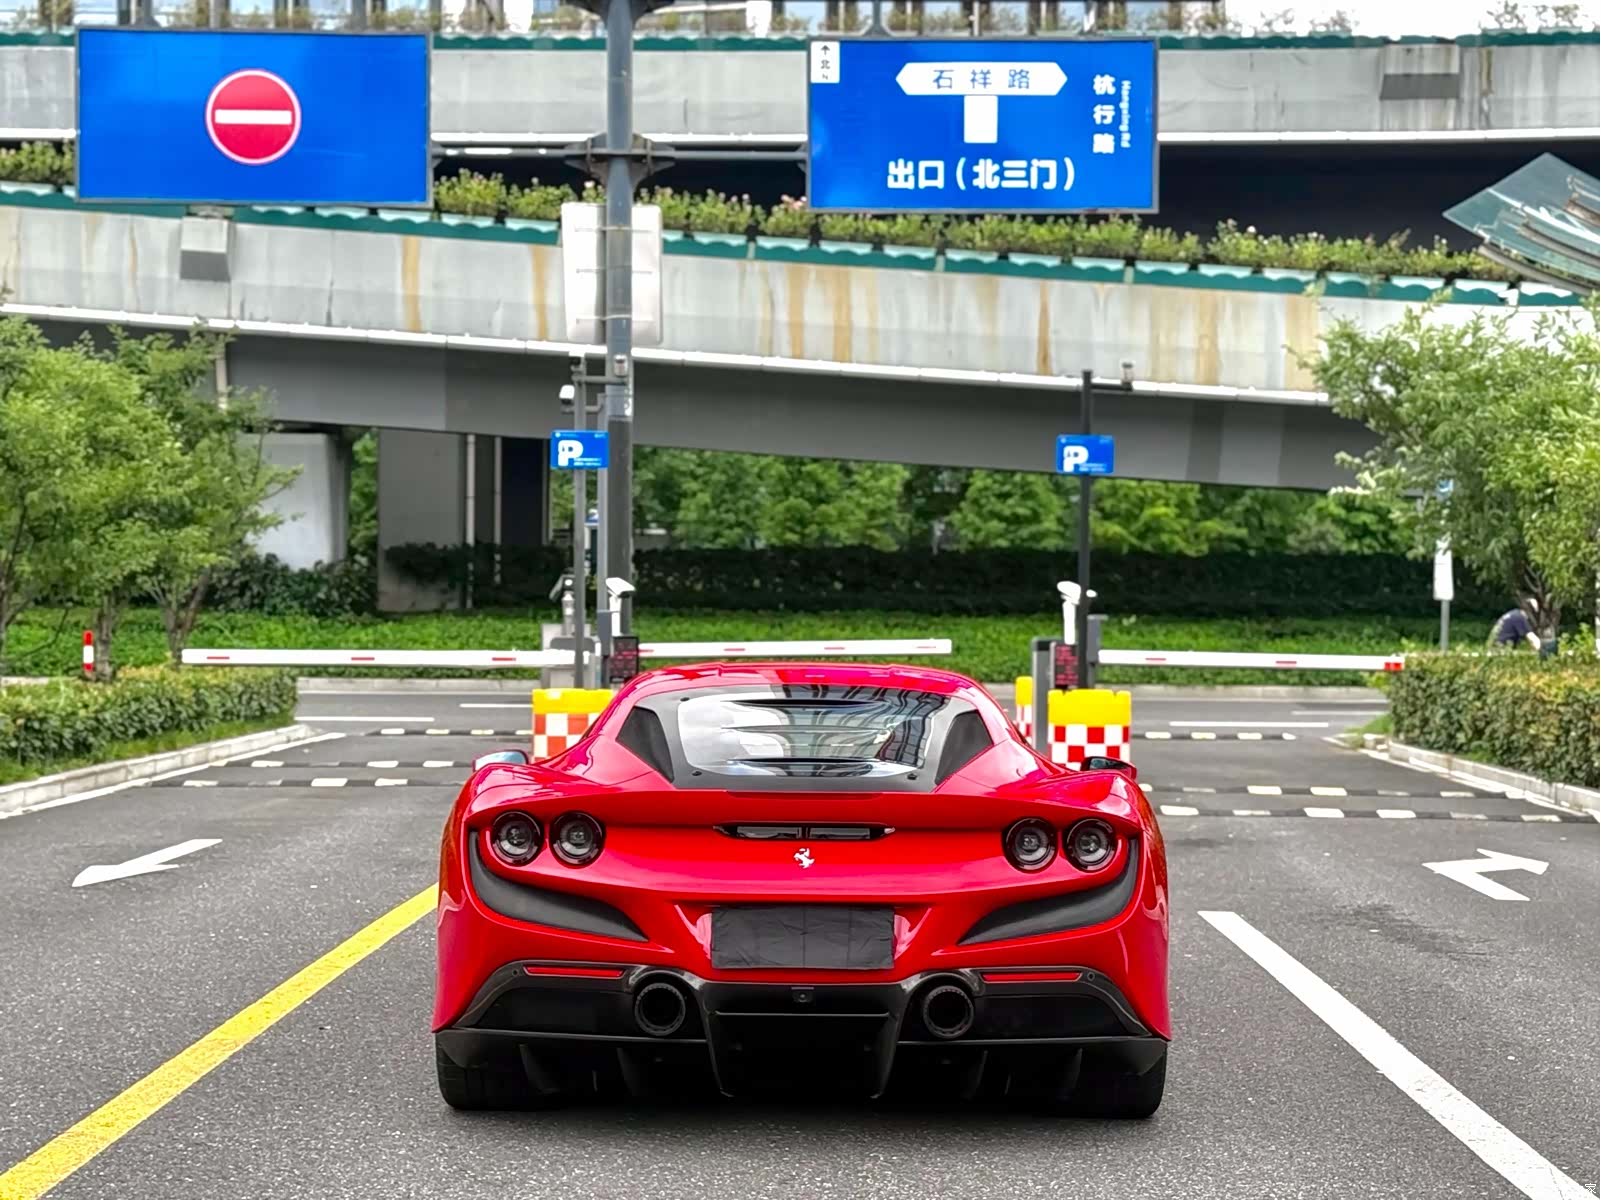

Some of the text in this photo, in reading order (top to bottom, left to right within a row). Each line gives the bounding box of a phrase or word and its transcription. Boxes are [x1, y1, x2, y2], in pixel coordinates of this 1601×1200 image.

[820, 59, 831, 70] 北
[932, 69, 1031, 90] 石祥路
[1092, 74, 1115, 154] 杭行路
